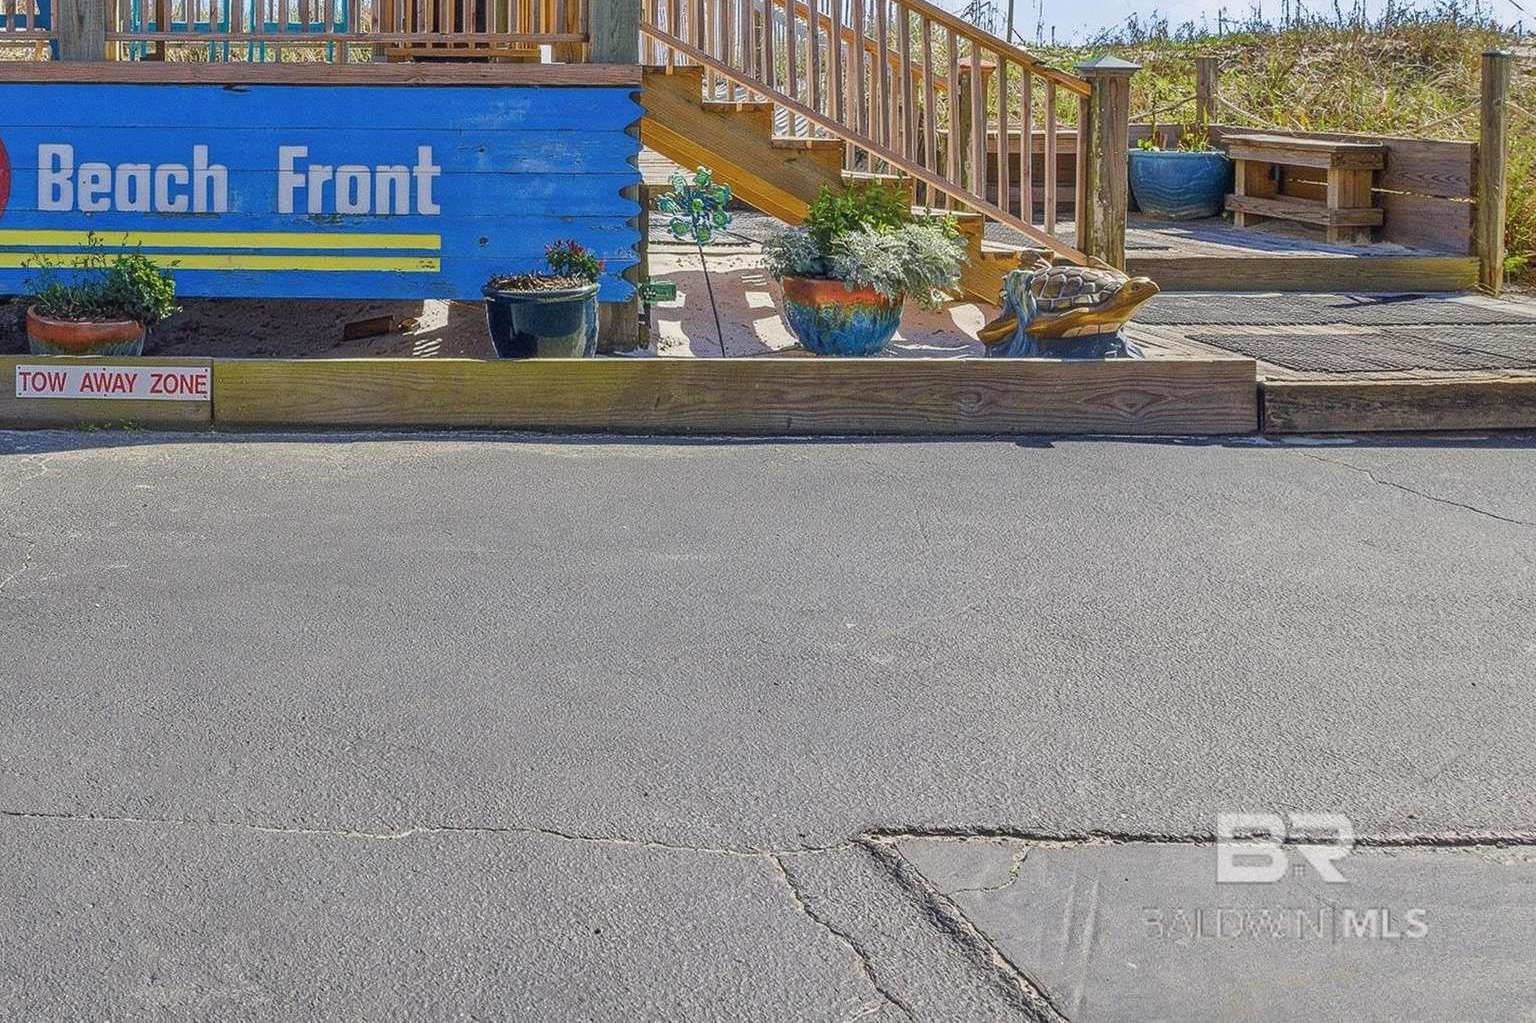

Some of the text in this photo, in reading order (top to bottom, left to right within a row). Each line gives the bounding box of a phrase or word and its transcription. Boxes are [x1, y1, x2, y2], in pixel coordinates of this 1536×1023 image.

[38, 143, 228, 213] Beach
[278, 145, 441, 215] Front
[19, 371, 208, 394] TOW AWAY ZONE
